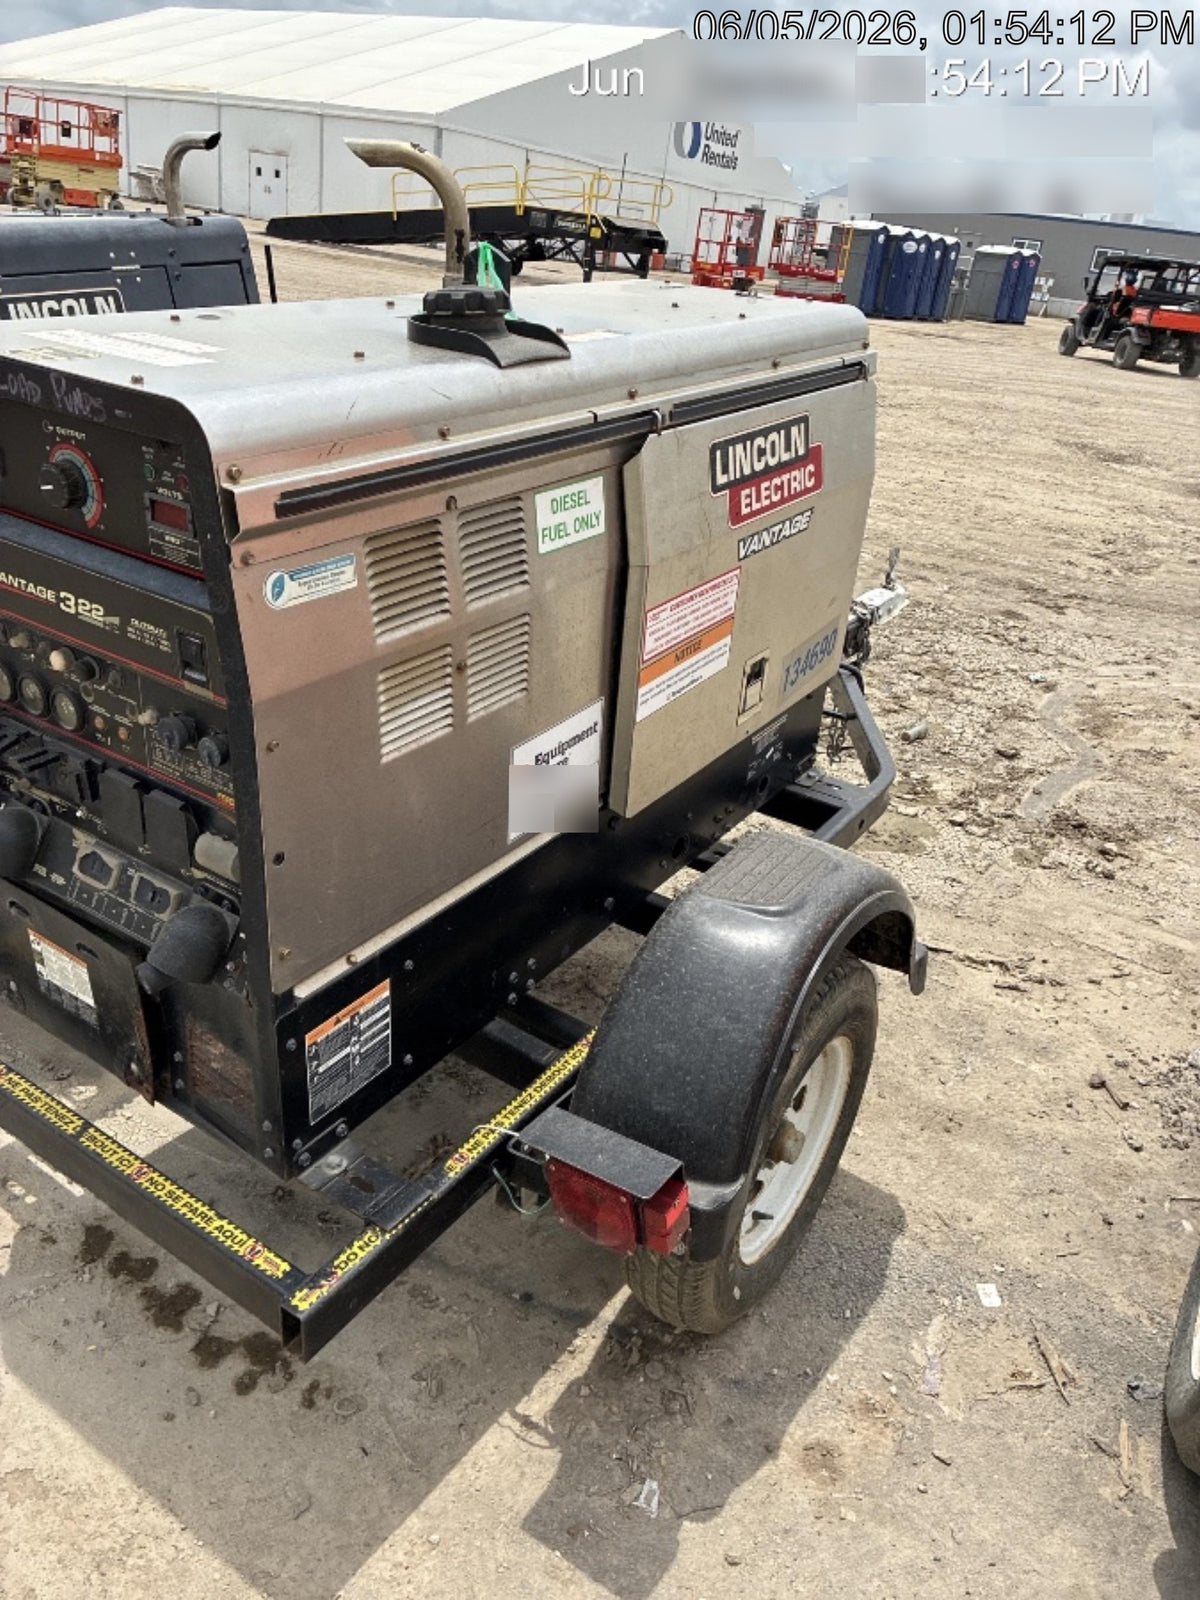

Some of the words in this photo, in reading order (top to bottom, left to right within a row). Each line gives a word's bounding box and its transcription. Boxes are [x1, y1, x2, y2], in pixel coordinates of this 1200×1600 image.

[704, 121, 741, 148] United
[701, 143, 739, 170] Rentals
[715, 422, 805, 487] LINCOLN
[550, 489, 591, 515] DIESEL
[740, 463, 816, 516] ELECTRIC
[541, 521, 571, 545] FUEL
[573, 510, 602, 534] ONLY
[738, 509, 812, 560] VANTAGE
[0, 571, 57, 602] ANTAGE
[59, 590, 105, 622] 322
[534, 720, 599, 766] Equipment
[502, 1092, 534, 1122] TENEZ
[146, 1175, 166, 1193] NO
[164, 1189, 184, 1205] SE
[181, 1200, 215, 1227] PARE
[357, 1234, 380, 1252] NO
